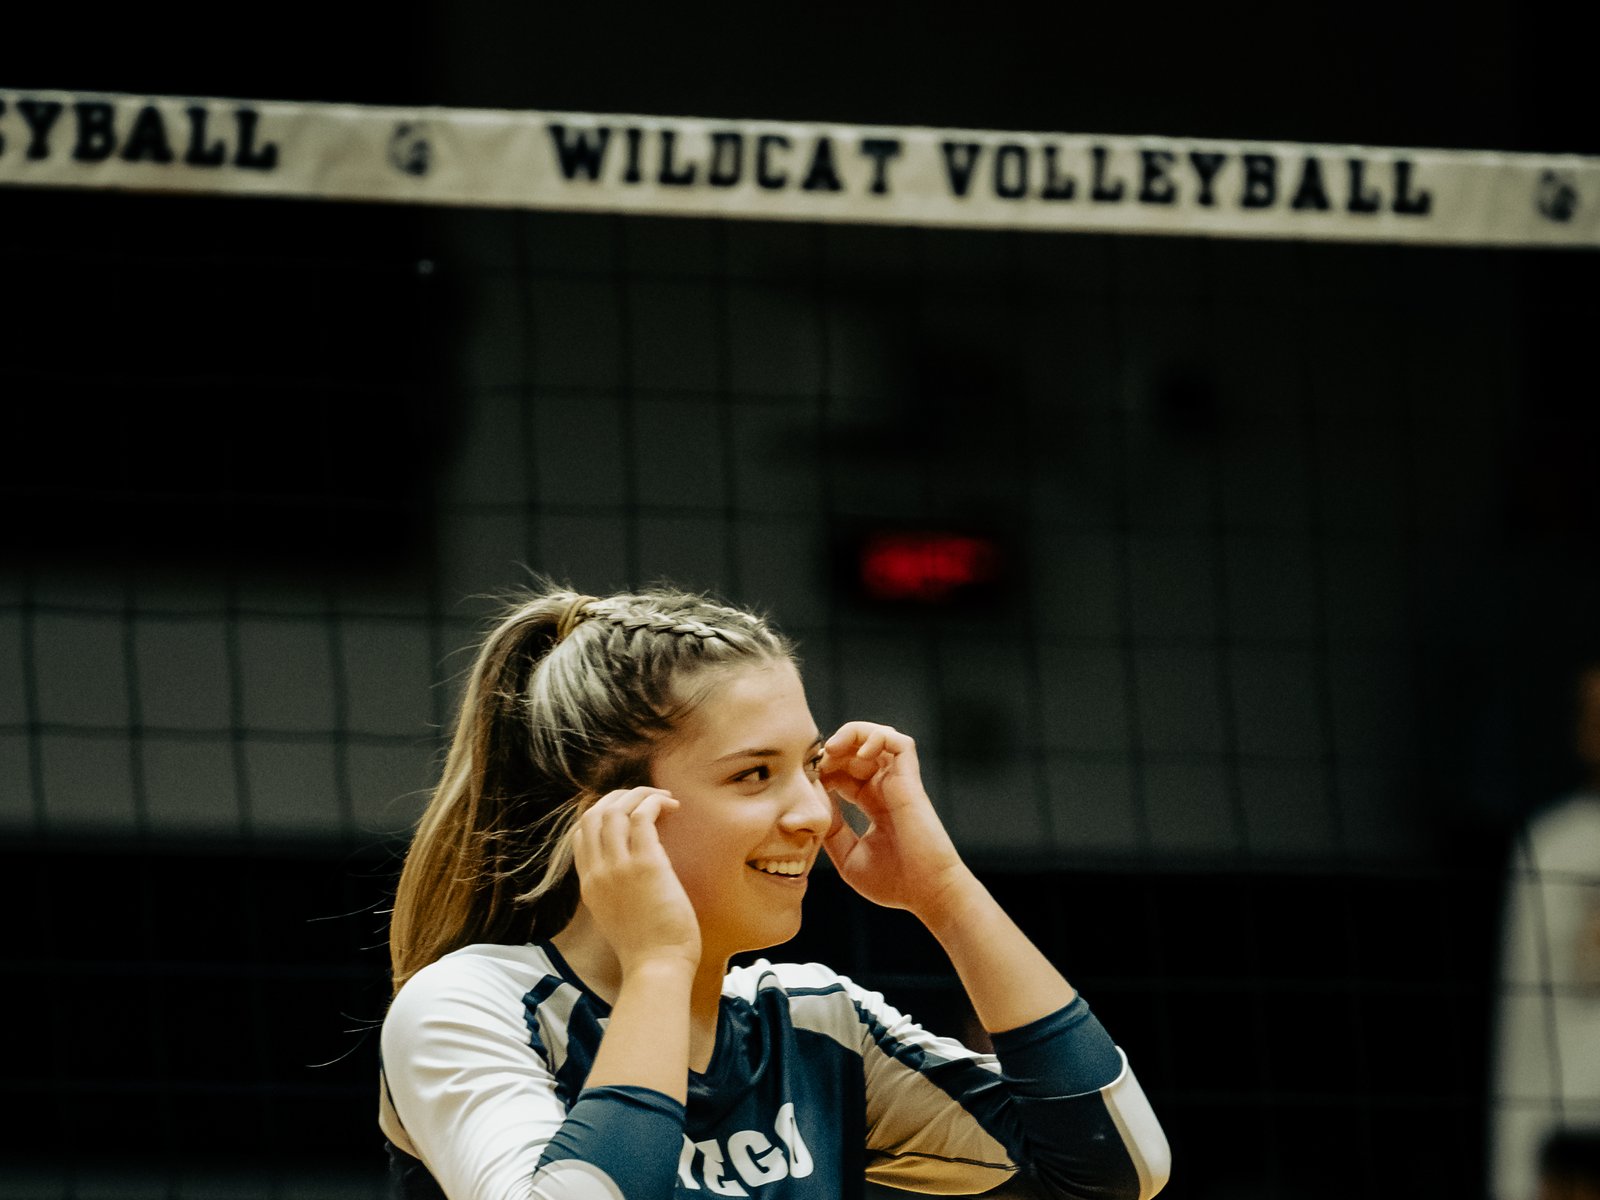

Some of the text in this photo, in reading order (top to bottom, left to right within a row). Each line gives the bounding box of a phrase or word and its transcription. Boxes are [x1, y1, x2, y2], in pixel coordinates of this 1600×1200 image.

[0, 101, 278, 170] YBALL
[548, 124, 1432, 215] WILDCAT VOLLEYBALL
